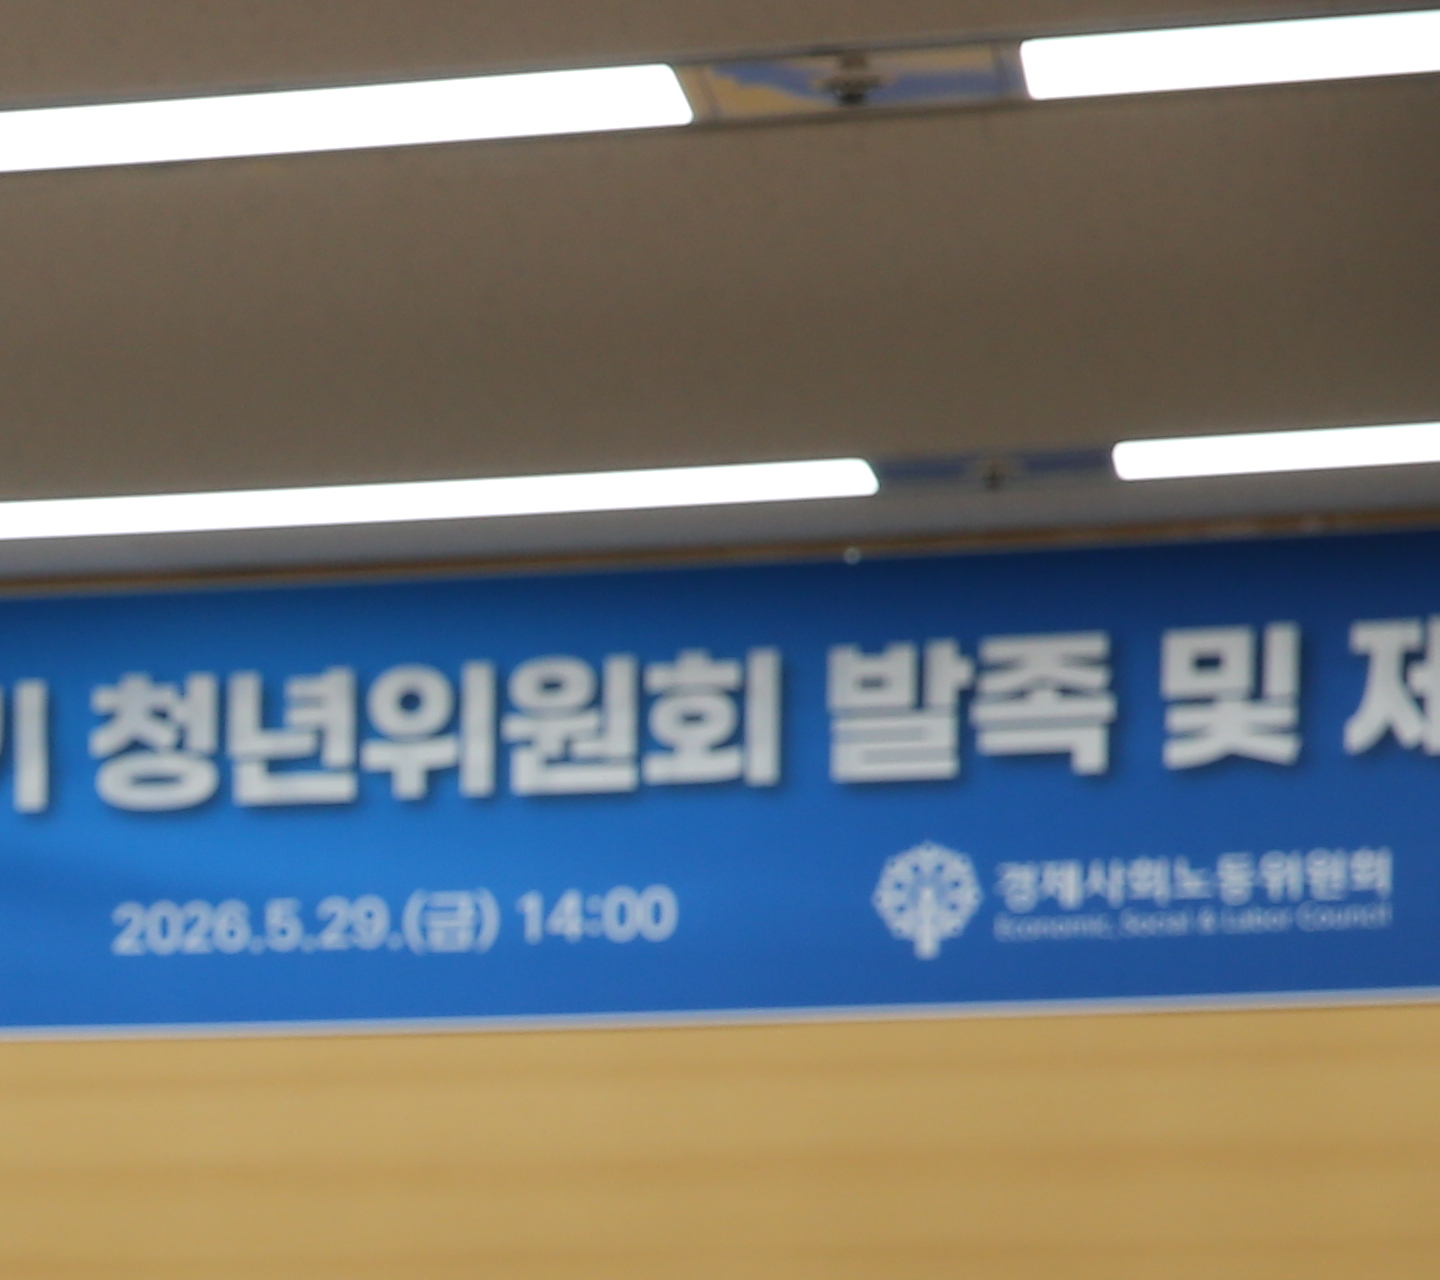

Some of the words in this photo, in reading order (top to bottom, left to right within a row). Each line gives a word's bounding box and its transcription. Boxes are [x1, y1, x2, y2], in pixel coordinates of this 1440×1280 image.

[88, 649, 782, 812] 청년위원회
[826, 630, 1117, 783] 발족
[1160, 621, 1302, 770] 및
[996, 845, 1392, 912] 경제사회노동위원회
[518, 884, 679, 946] 14:00
